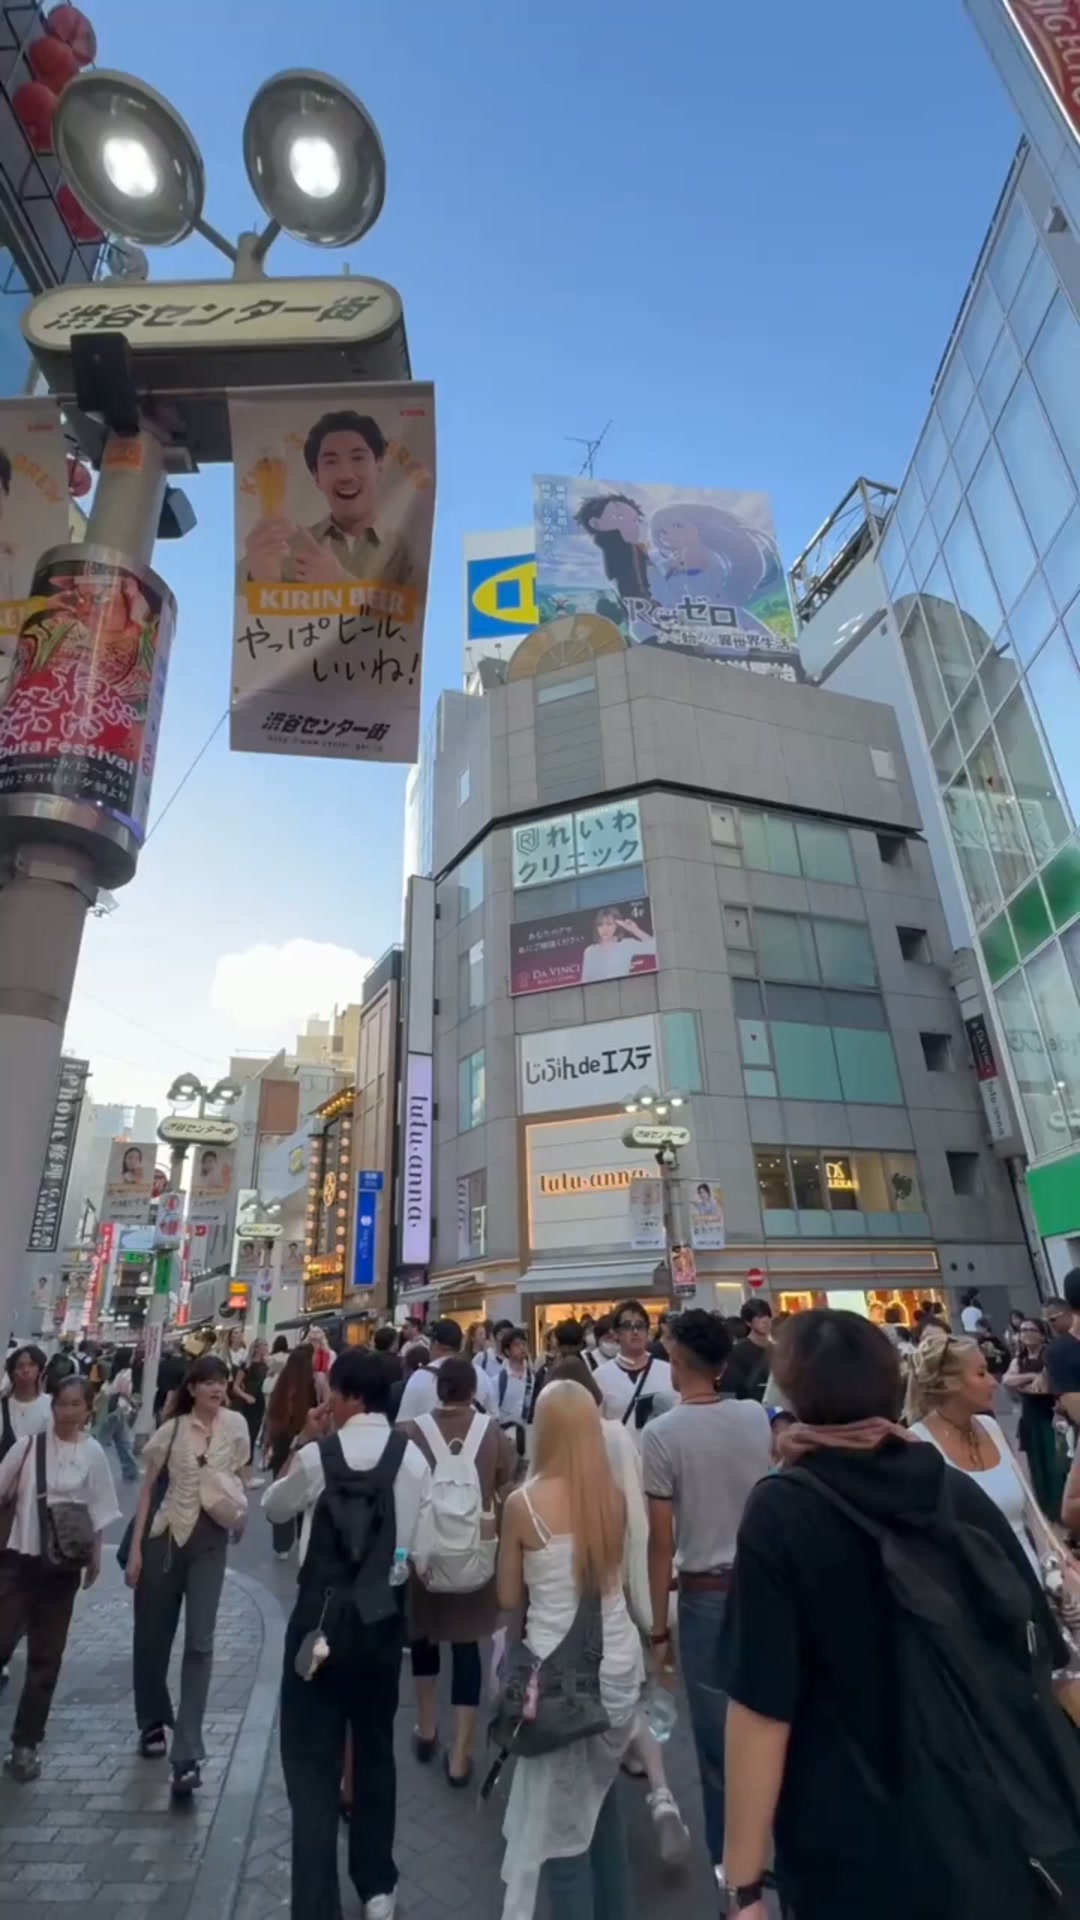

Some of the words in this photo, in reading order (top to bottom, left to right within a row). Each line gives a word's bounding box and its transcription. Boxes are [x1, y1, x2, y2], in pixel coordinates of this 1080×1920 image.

[43, 295, 381, 330] 渋谷センター街
[259, 588, 344, 611] KIRIN
[349, 587, 406, 616] BEER
[312, 648, 420, 686] いいね!
[261, 711, 392, 742] 渋谷センター街
[44, 737, 135, 776] Festival
[546, 809, 638, 848] れいわ
[517, 838, 640, 884] クリニック
